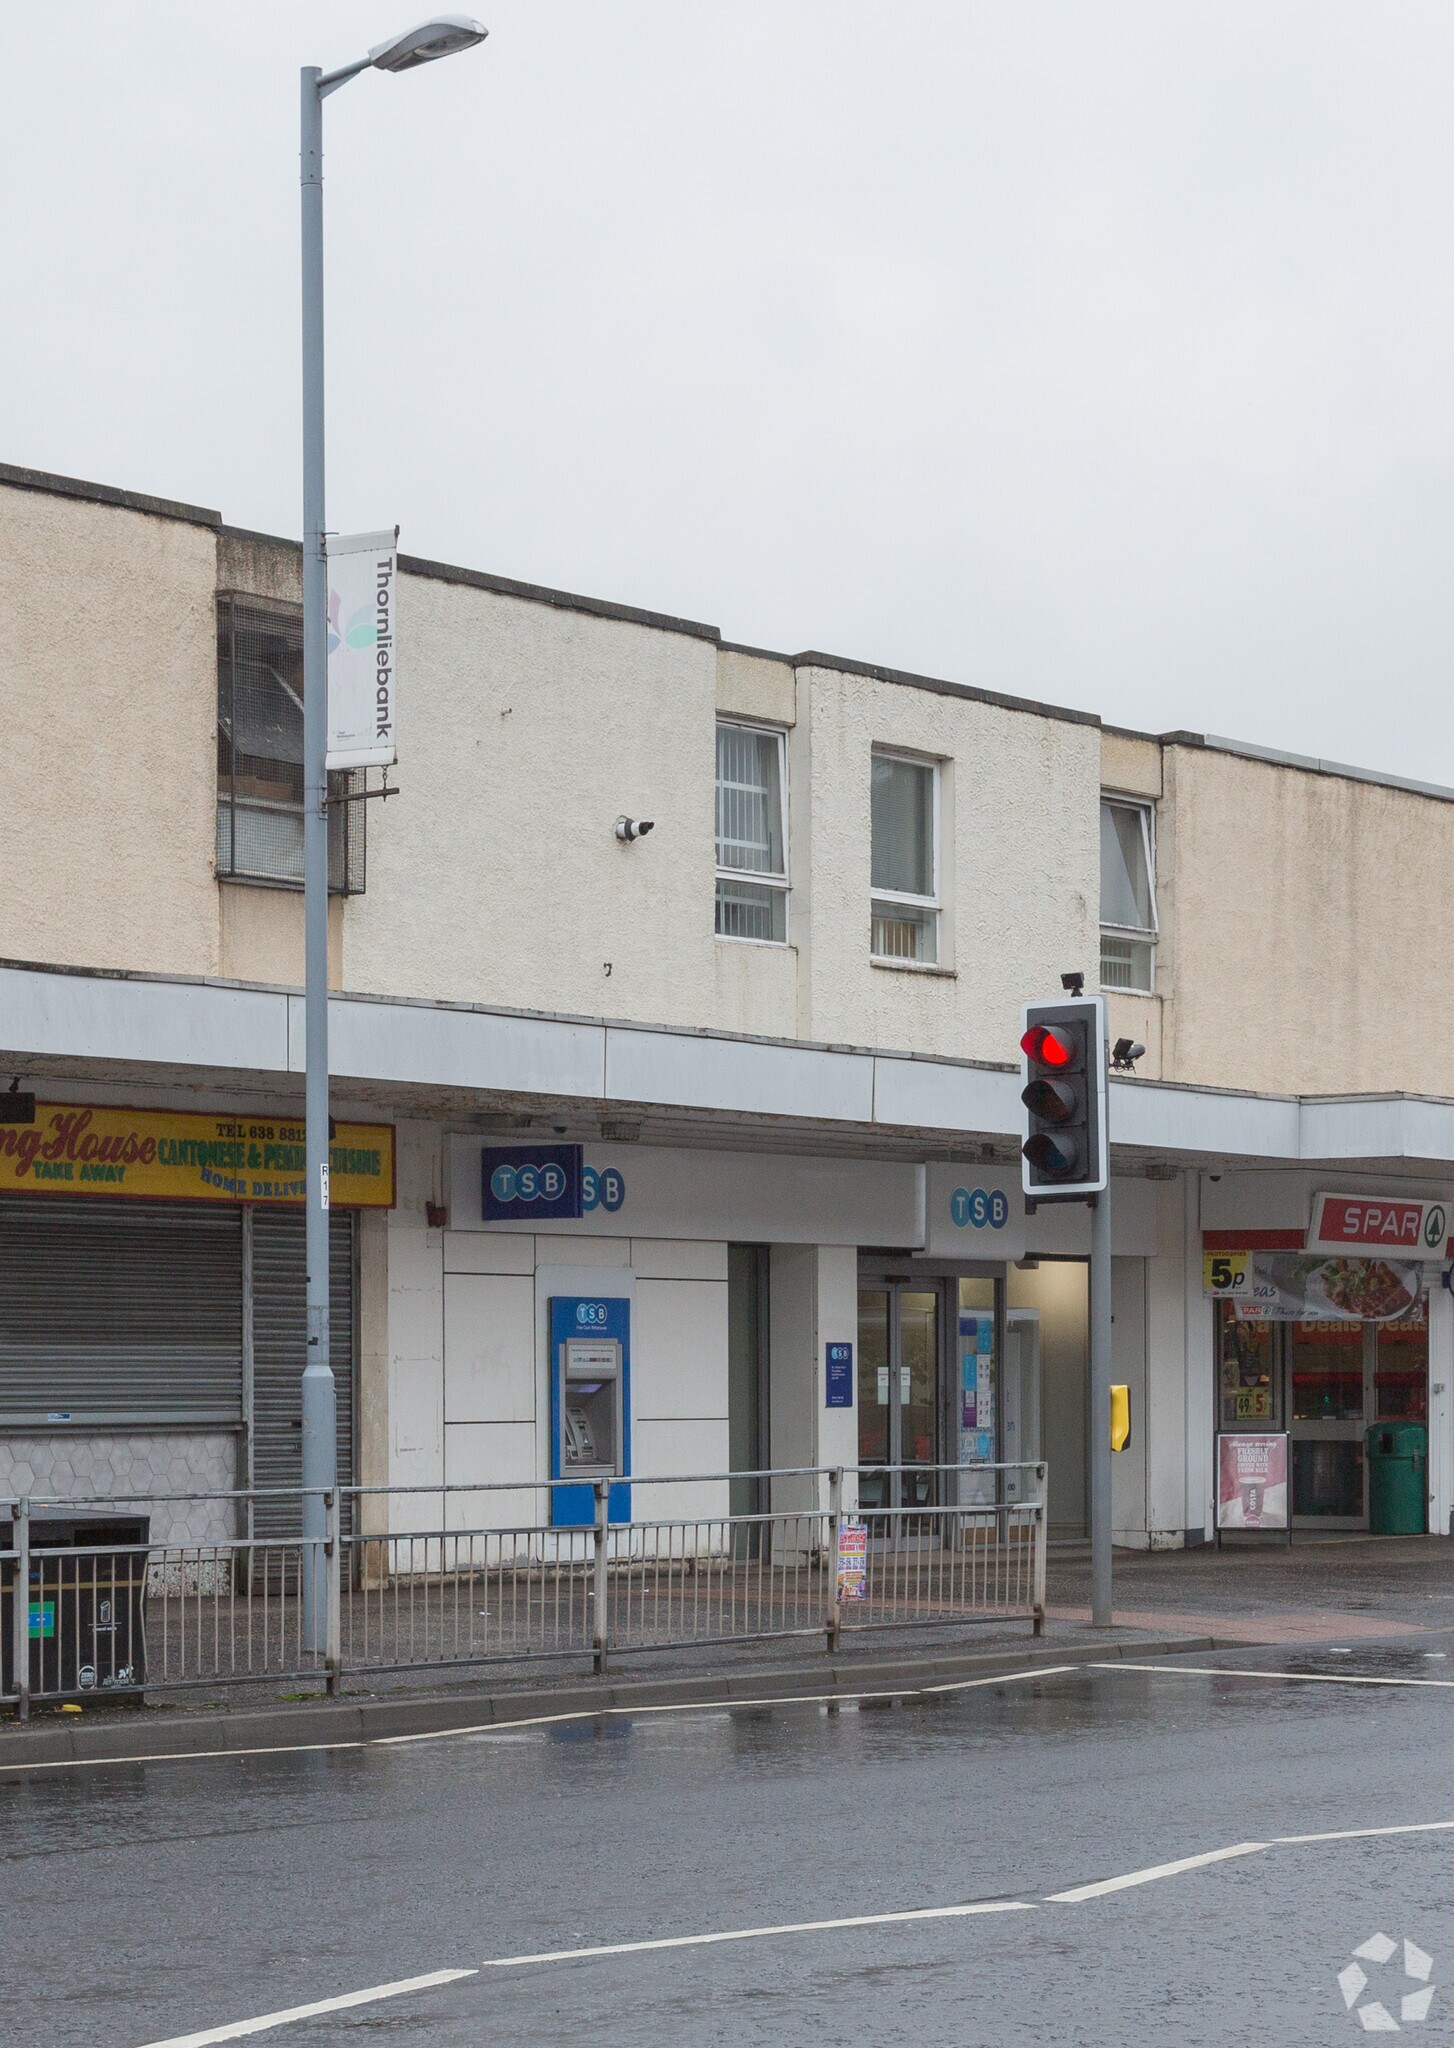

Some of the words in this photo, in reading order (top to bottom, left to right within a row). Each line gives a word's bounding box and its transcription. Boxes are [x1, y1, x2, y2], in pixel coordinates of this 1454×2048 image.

[376, 556, 393, 739] Thornliebank
[41, 1109, 157, 1165] House
[216, 1123, 247, 1138] TEL
[249, 1126, 275, 1140] 638
[279, 1127, 306, 1142] 881
[157, 1137, 246, 1169] CANTONESE
[247, 1142, 263, 1170] &
[32, 1160, 74, 1181] TAKE
[79, 1163, 127, 1183] AWAY
[201, 1166, 247, 1195] HOME
[252, 1180, 306, 1197] DELIVE
[498, 1170, 561, 1195] TSB
[582, 1174, 621, 1204] SB
[954, 1194, 1005, 1222] TSB
[1342, 1207, 1420, 1239] SPAR
[1211, 1258, 1245, 1289] 5p
[579, 1307, 606, 1320] TSB
[1249, 1488, 1257, 1511] COSTA
